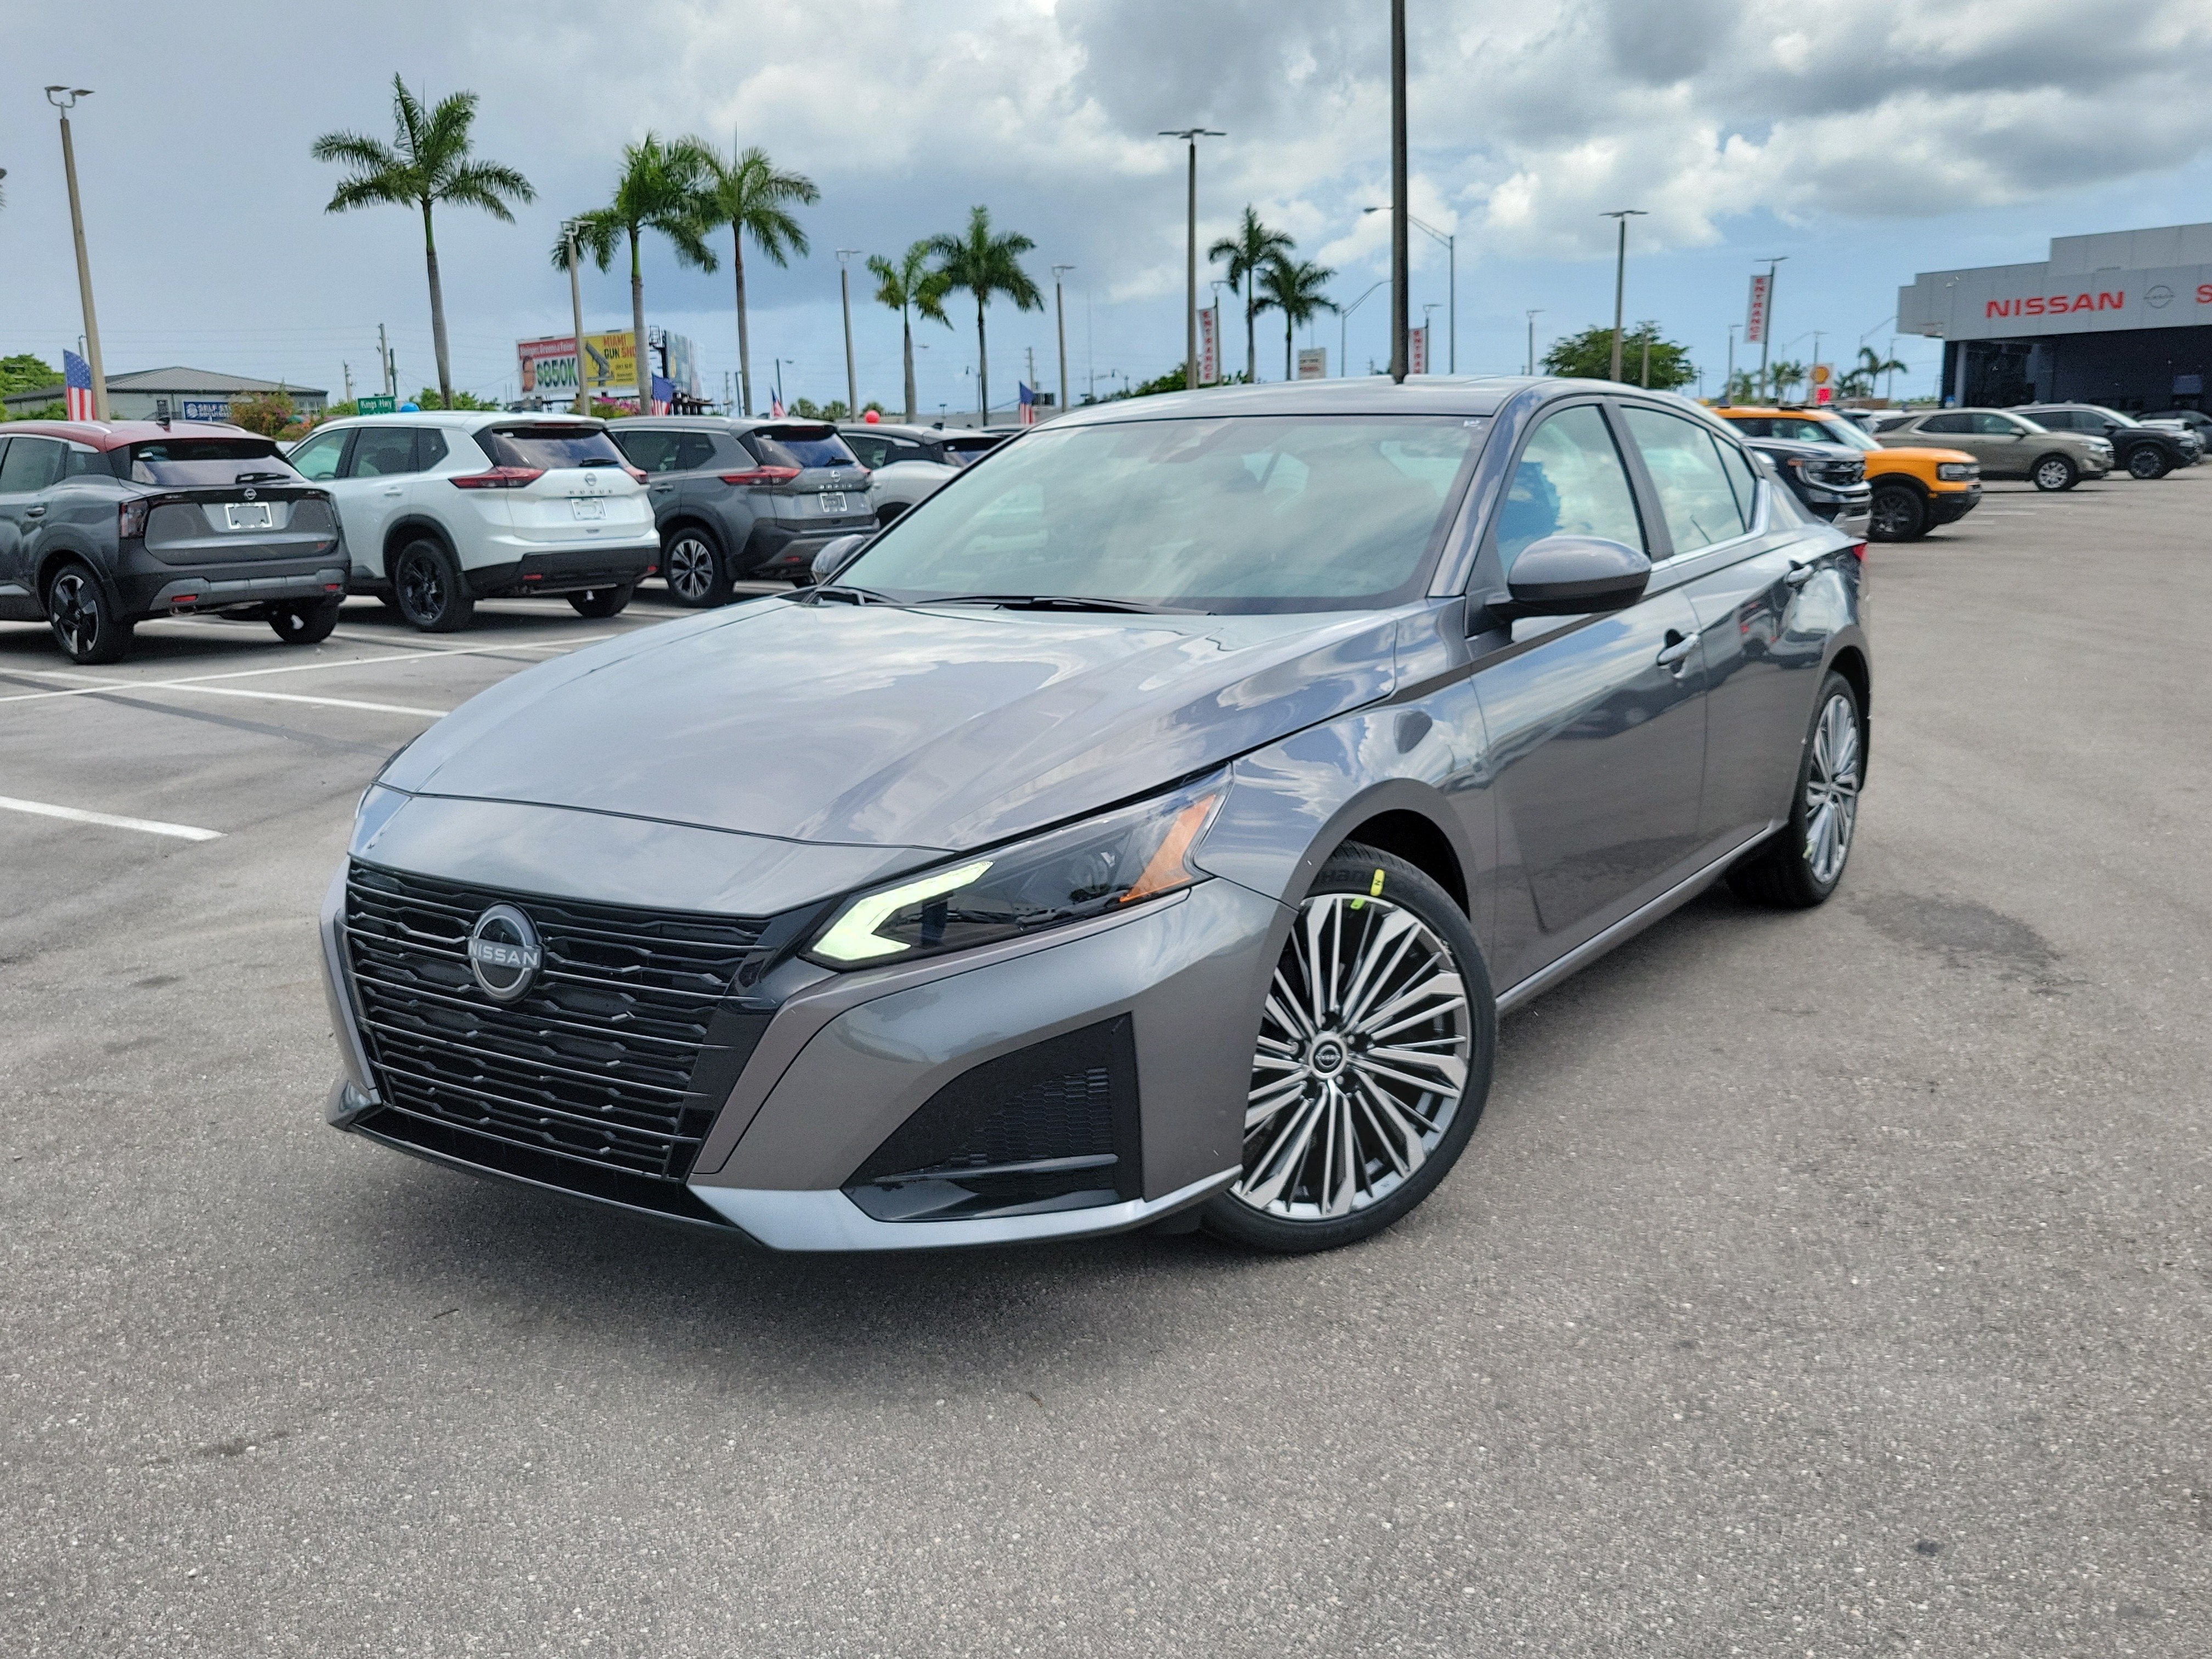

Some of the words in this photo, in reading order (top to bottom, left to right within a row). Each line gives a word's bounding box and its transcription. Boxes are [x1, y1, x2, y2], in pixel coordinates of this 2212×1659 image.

[1750, 278, 1764, 340] ENTRANCE
[1986, 291, 2124, 318] NISSAN
[603, 334, 626, 347] MIAMI
[604, 347, 620, 359] GUN
[622, 346, 636, 358] SHO
[1202, 311, 1212, 380] ENTRANCE
[1413, 330, 1422, 373] ENTRAN
[537, 357, 579, 387] $850K
[360, 400, 377, 410] Kings
[380, 399, 392, 409] Hwy
[469, 939, 538, 966] NISSAN
